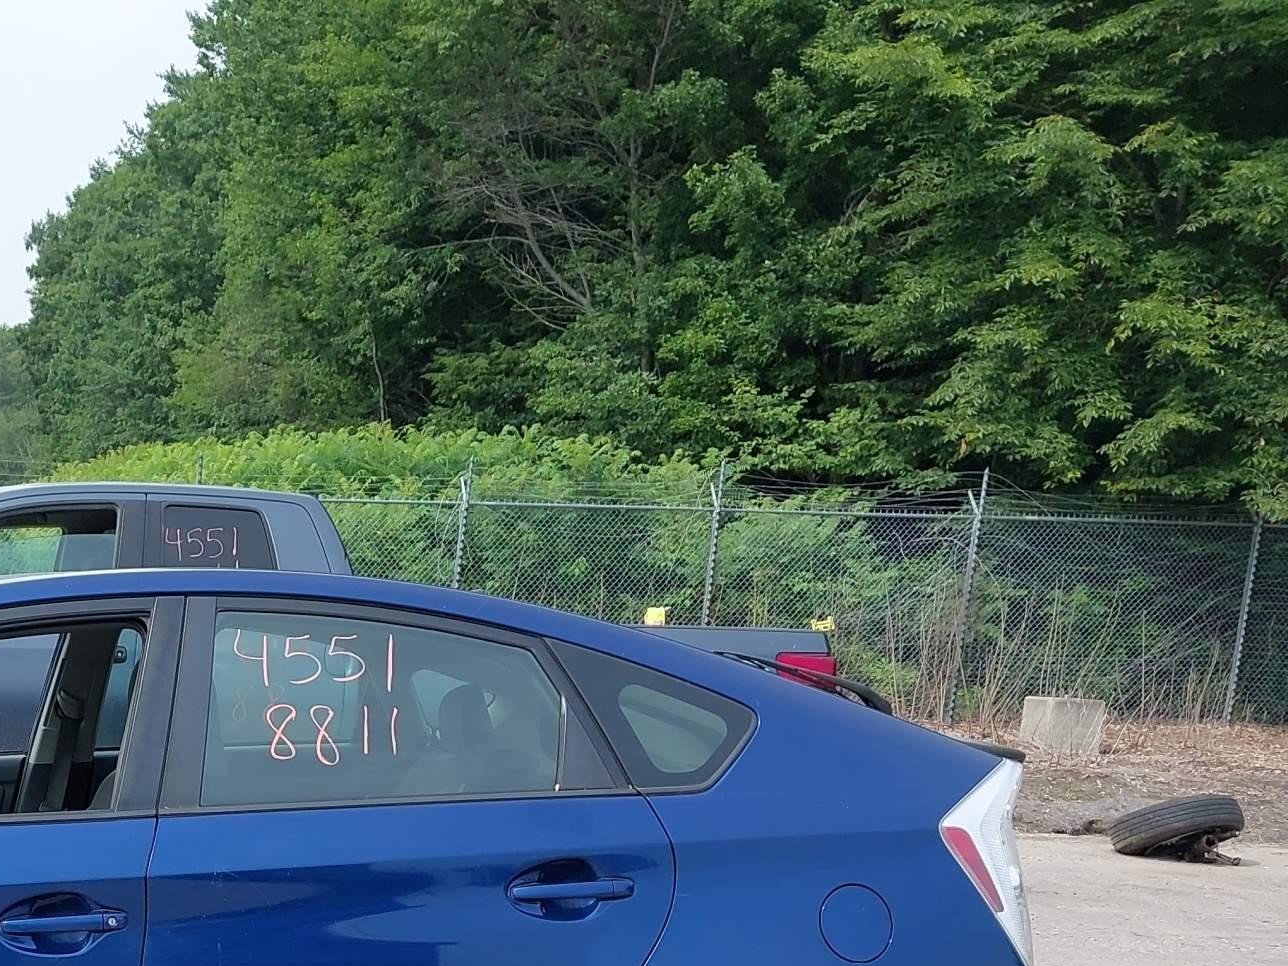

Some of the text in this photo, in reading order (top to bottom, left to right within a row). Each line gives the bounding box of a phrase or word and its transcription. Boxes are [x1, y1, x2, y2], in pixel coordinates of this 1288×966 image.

[165, 527, 237, 561] 4551
[233, 628, 394, 693] 4551
[266, 704, 399, 766] 8811
